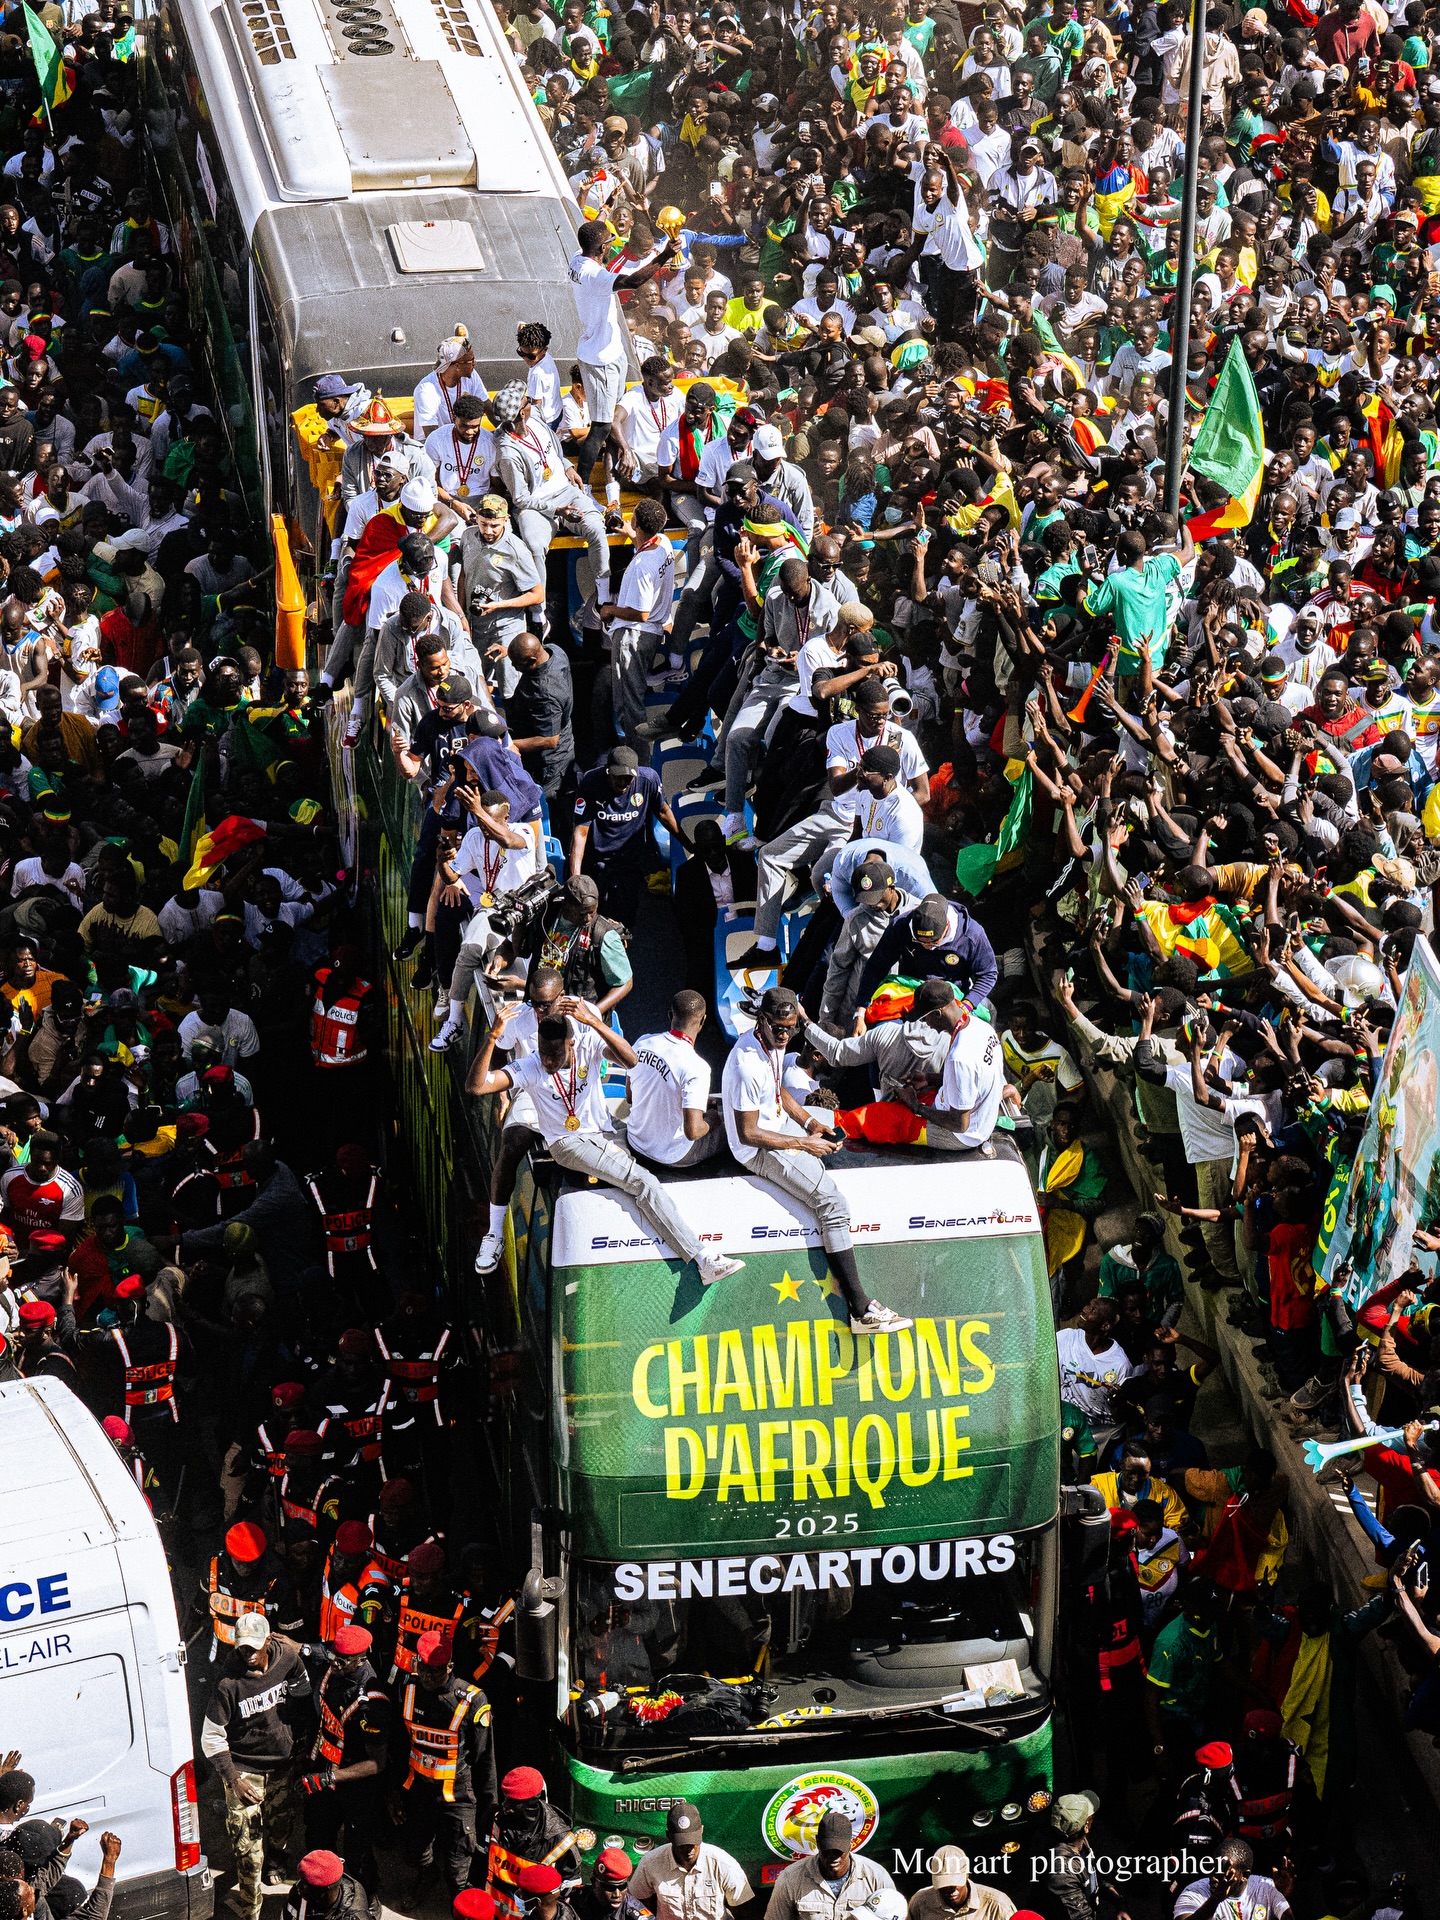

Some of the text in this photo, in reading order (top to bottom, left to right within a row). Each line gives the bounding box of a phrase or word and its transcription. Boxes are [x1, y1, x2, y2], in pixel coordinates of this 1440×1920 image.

[597, 810, 639, 821] Orange
[330, 1009, 357, 1022] POLICE
[325, 1212, 371, 1230] POLICE
[632, 1317, 996, 1418] CHAMPIONS
[664, 1405, 974, 1510] D'AFRIQUE
[775, 1513, 860, 1539] 2025
[614, 1535, 1016, 1601] SENECARTOURS
[803, 1774, 873, 1808] SÉNÉGALAISE
